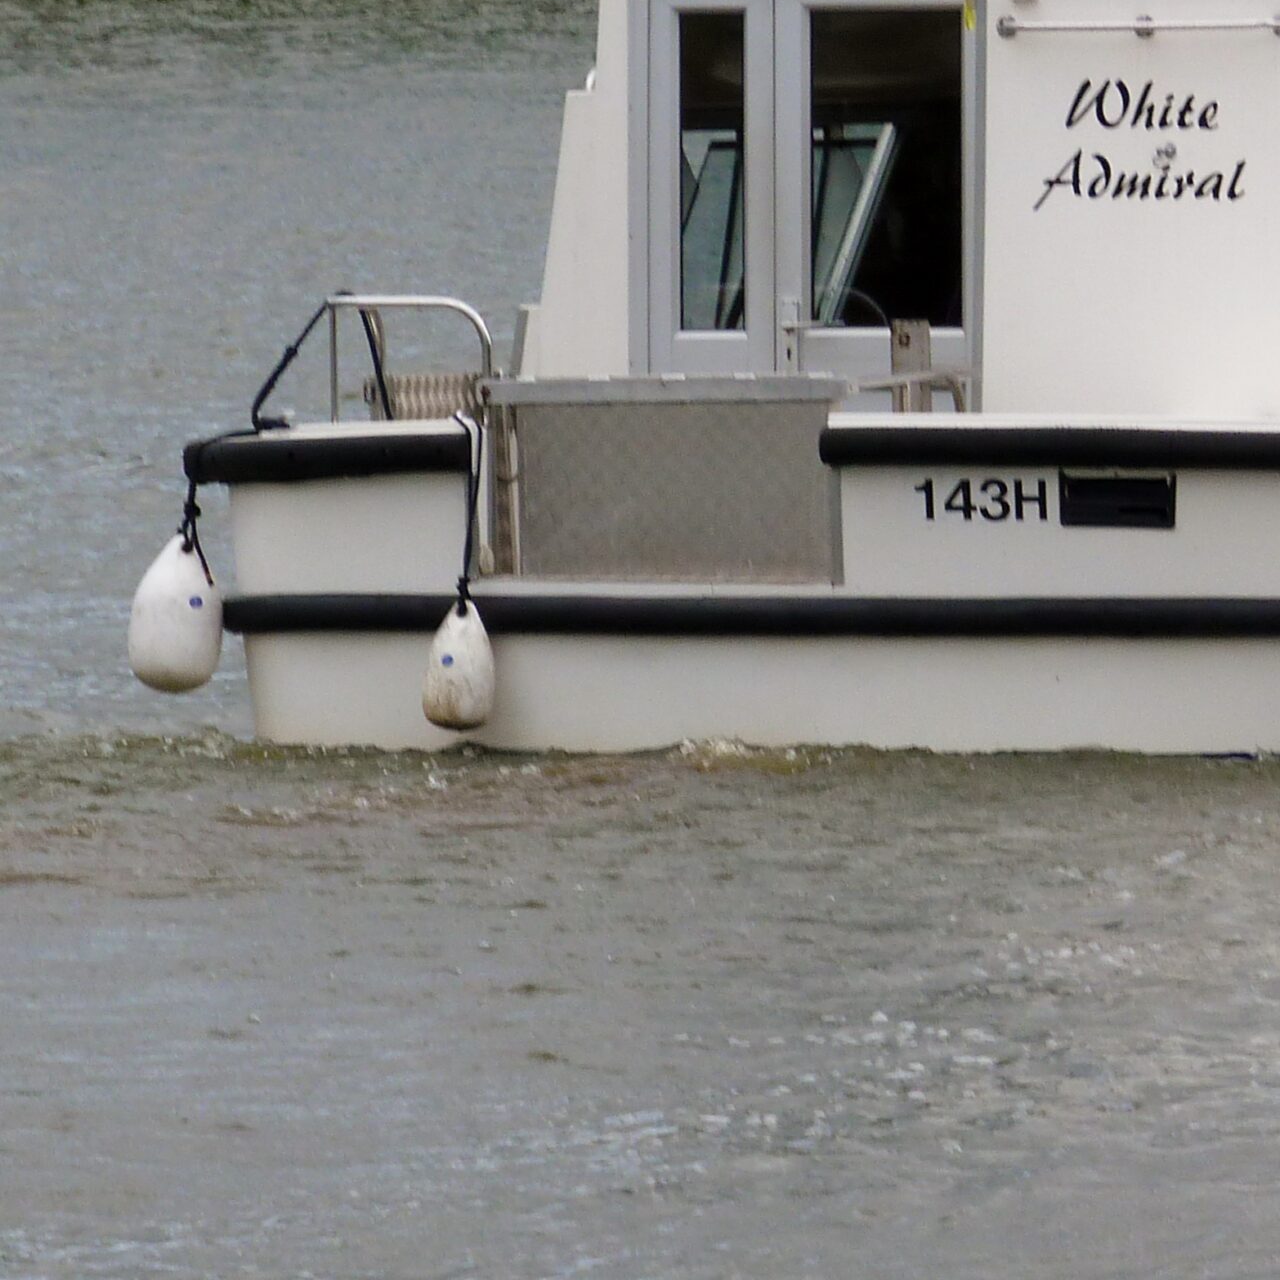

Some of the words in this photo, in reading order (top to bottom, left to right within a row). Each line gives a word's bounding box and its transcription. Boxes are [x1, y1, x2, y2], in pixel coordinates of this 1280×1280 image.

[1065, 77, 1219, 129] White
[1033, 147, 1247, 211] Admiral
[914, 477, 1048, 521] 143H
